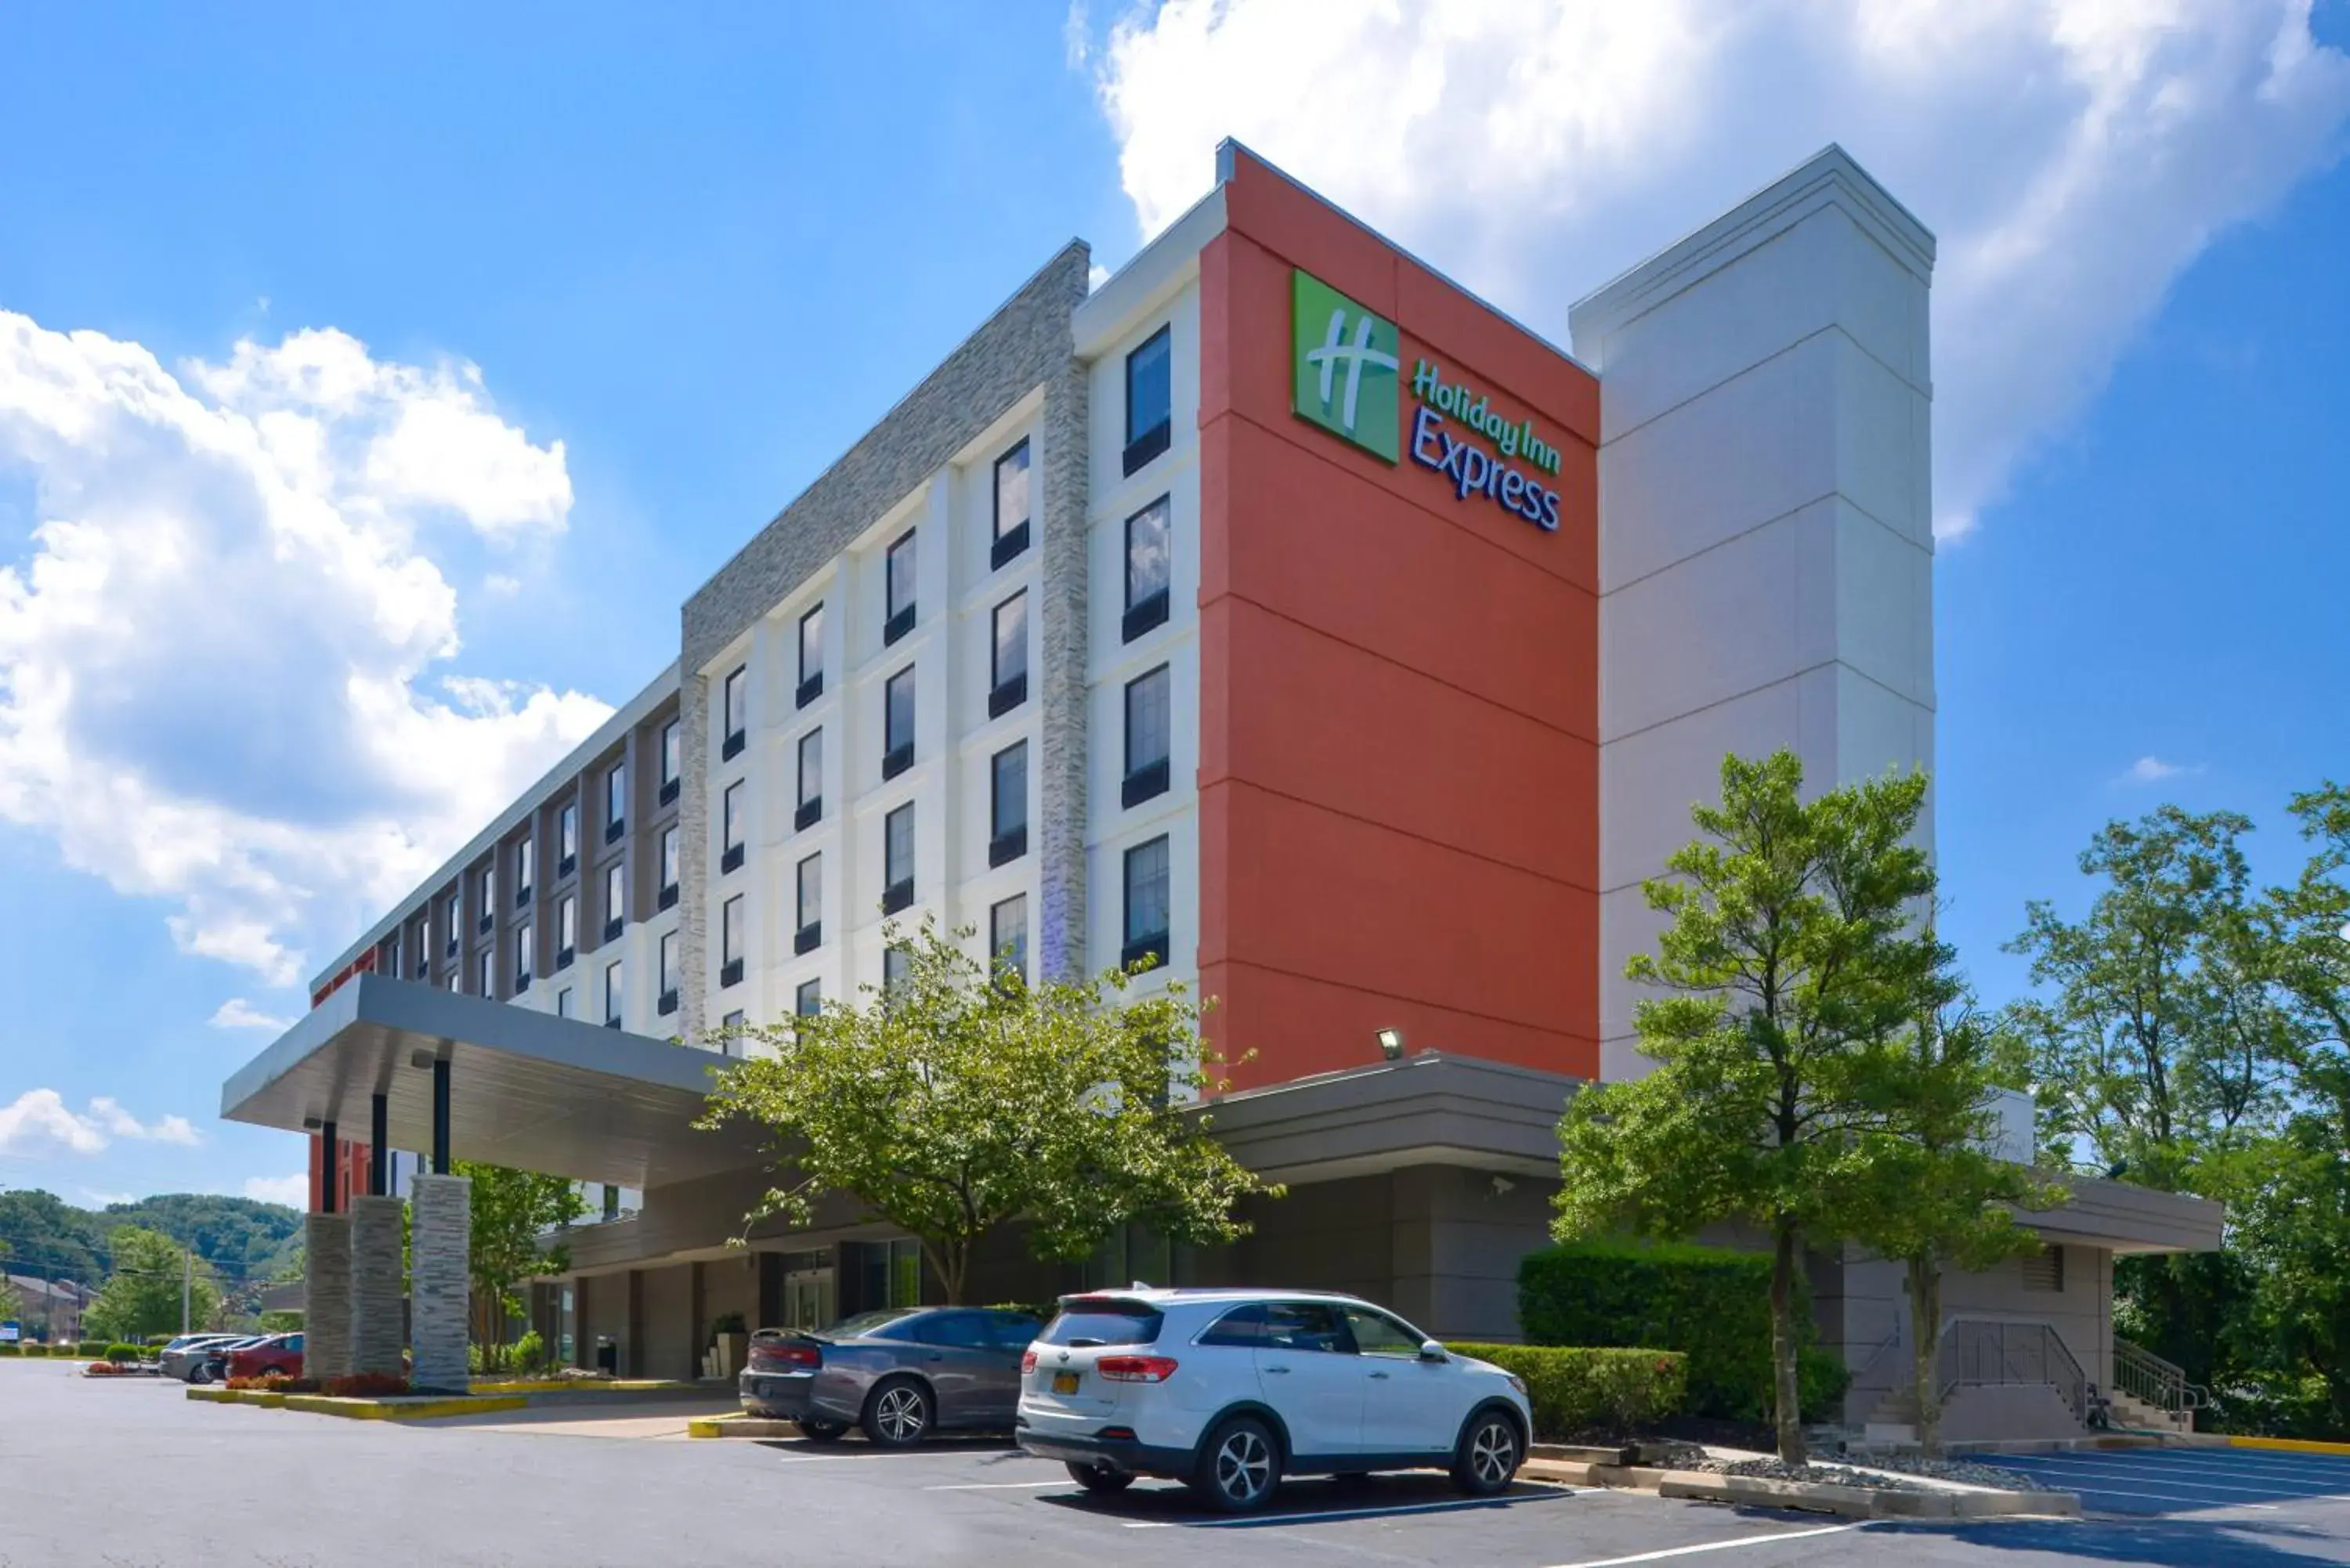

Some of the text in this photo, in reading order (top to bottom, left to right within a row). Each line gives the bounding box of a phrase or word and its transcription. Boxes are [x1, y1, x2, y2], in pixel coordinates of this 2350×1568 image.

[1412, 358, 1561, 475] Holiday Inn
[1412, 406, 1561, 533] Express
